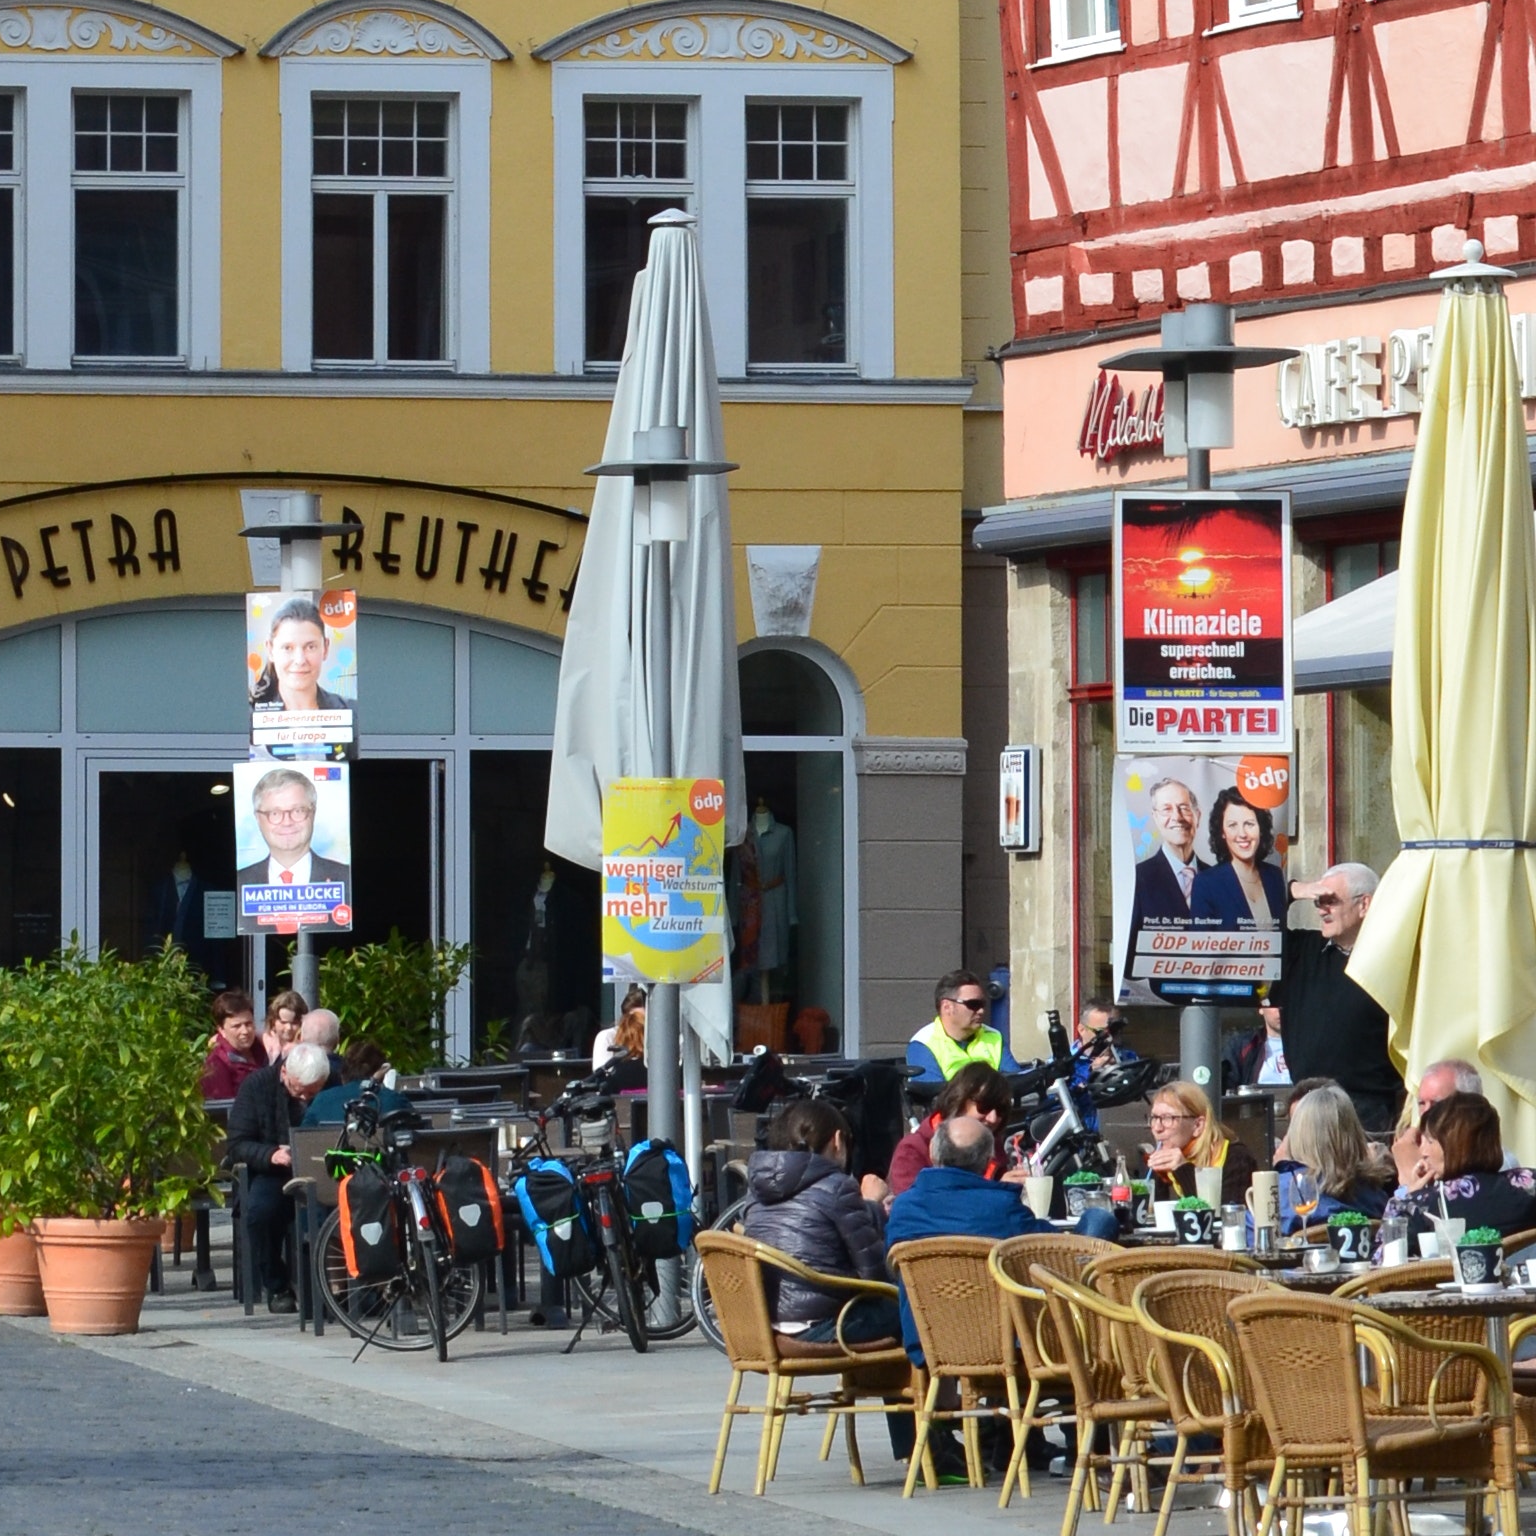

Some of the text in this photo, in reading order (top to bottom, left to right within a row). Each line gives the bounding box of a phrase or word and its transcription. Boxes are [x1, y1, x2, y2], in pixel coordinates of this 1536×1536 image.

[0, 505, 572, 615] PETRA REUTHE
[324, 600, 355, 616] ödp
[1143, 608, 1262, 636] Klimaziele
[1160, 641, 1245, 661] superschnell
[1169, 663, 1236, 679] erreichen.
[1129, 707, 1279, 735] Die PARTEI
[292, 731, 326, 742] Europa
[1244, 765, 1289, 791] ödp
[693, 792, 724, 811] ödp
[605, 859, 683, 882] weniger
[245, 885, 341, 902] MARTIN LÜCKE
[625, 879, 650, 896] ist
[662, 878, 719, 891] Wachstum
[298, 903, 327, 911] EUROPA
[606, 893, 668, 917] mehr
[652, 916, 704, 931] Zukunft
[1152, 933, 1270, 951] ÖDP wieder ins
[1152, 960, 1265, 977] EU-Parlament
[1183, 1211, 1213, 1242] 32
[1337, 1227, 1371, 1259] 28
